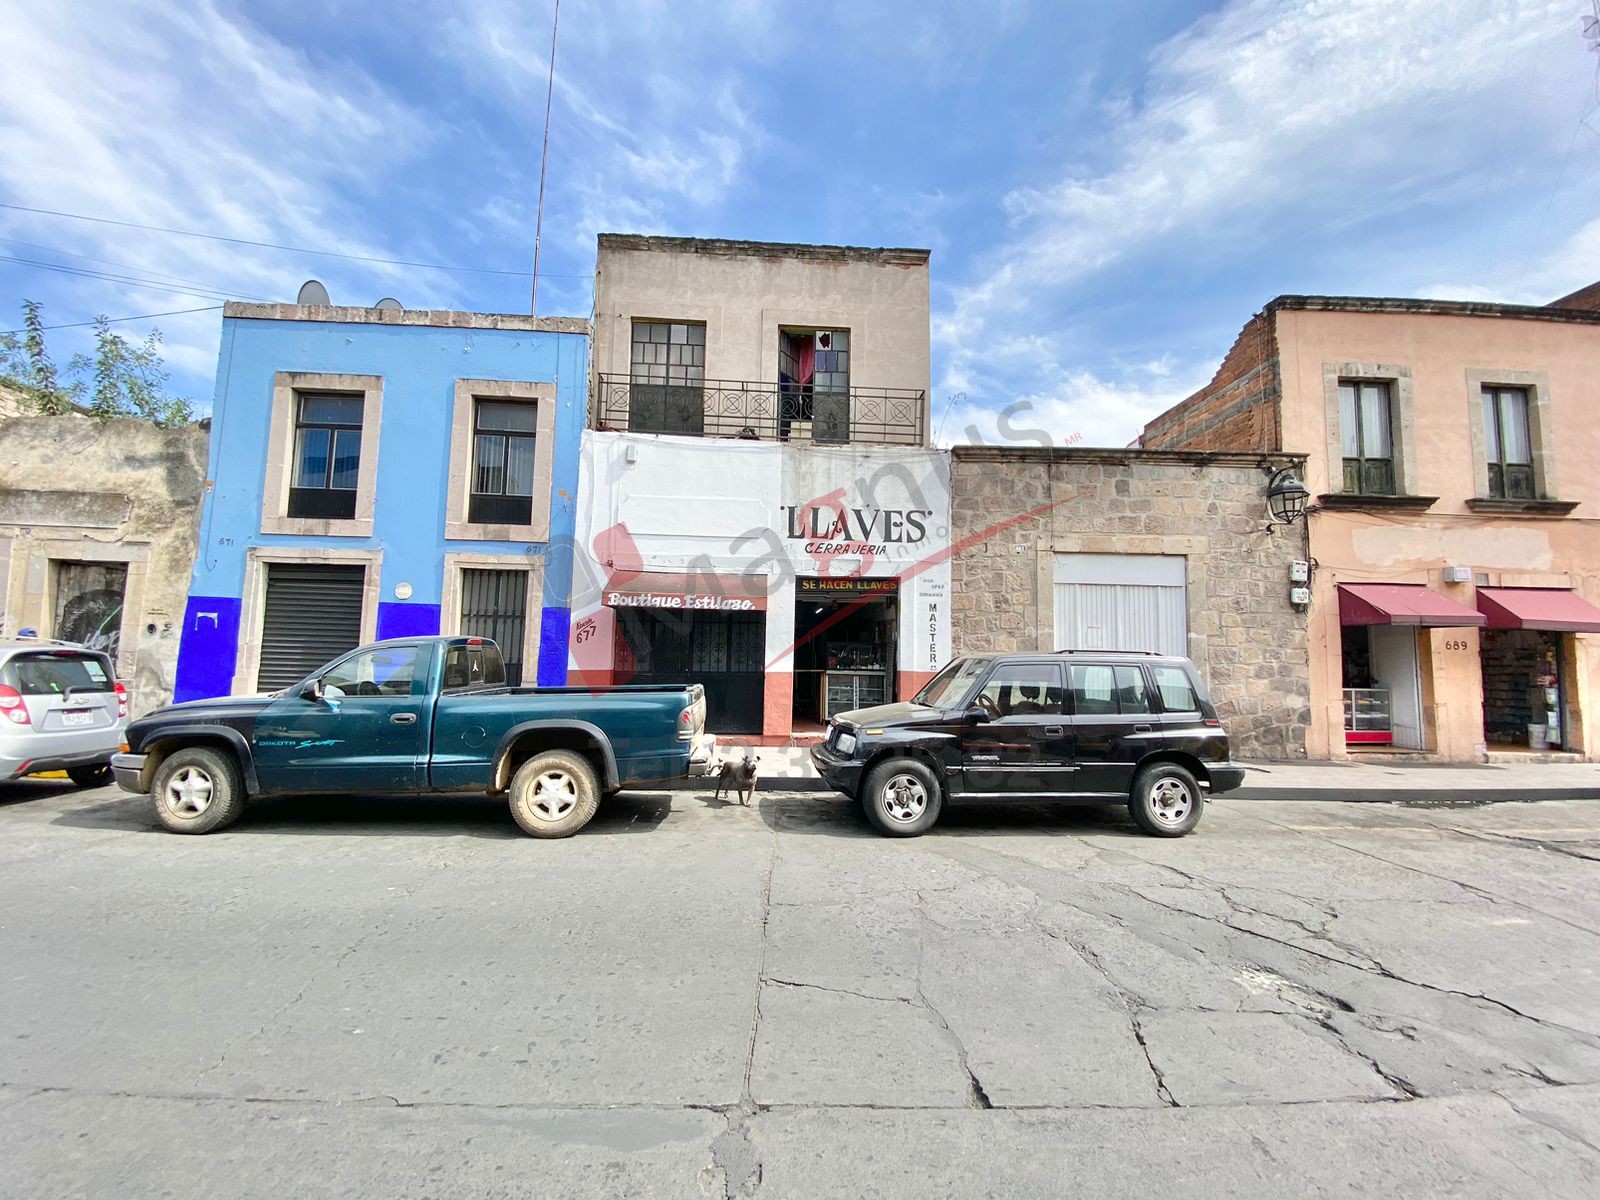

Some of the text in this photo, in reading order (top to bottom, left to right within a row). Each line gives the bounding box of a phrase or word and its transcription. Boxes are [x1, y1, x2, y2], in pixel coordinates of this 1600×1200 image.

[786, 505, 927, 543] LLAVES
[218, 537, 234, 547] 671
[804, 542, 887, 556] CERRAJERIA
[802, 580, 897, 590] SE HACEN LLAVES
[607, 592, 682, 608] Boutique
[576, 625, 597, 644] 677
[929, 603, 938, 663] MASTER
[1445, 640, 1468, 651] 689
